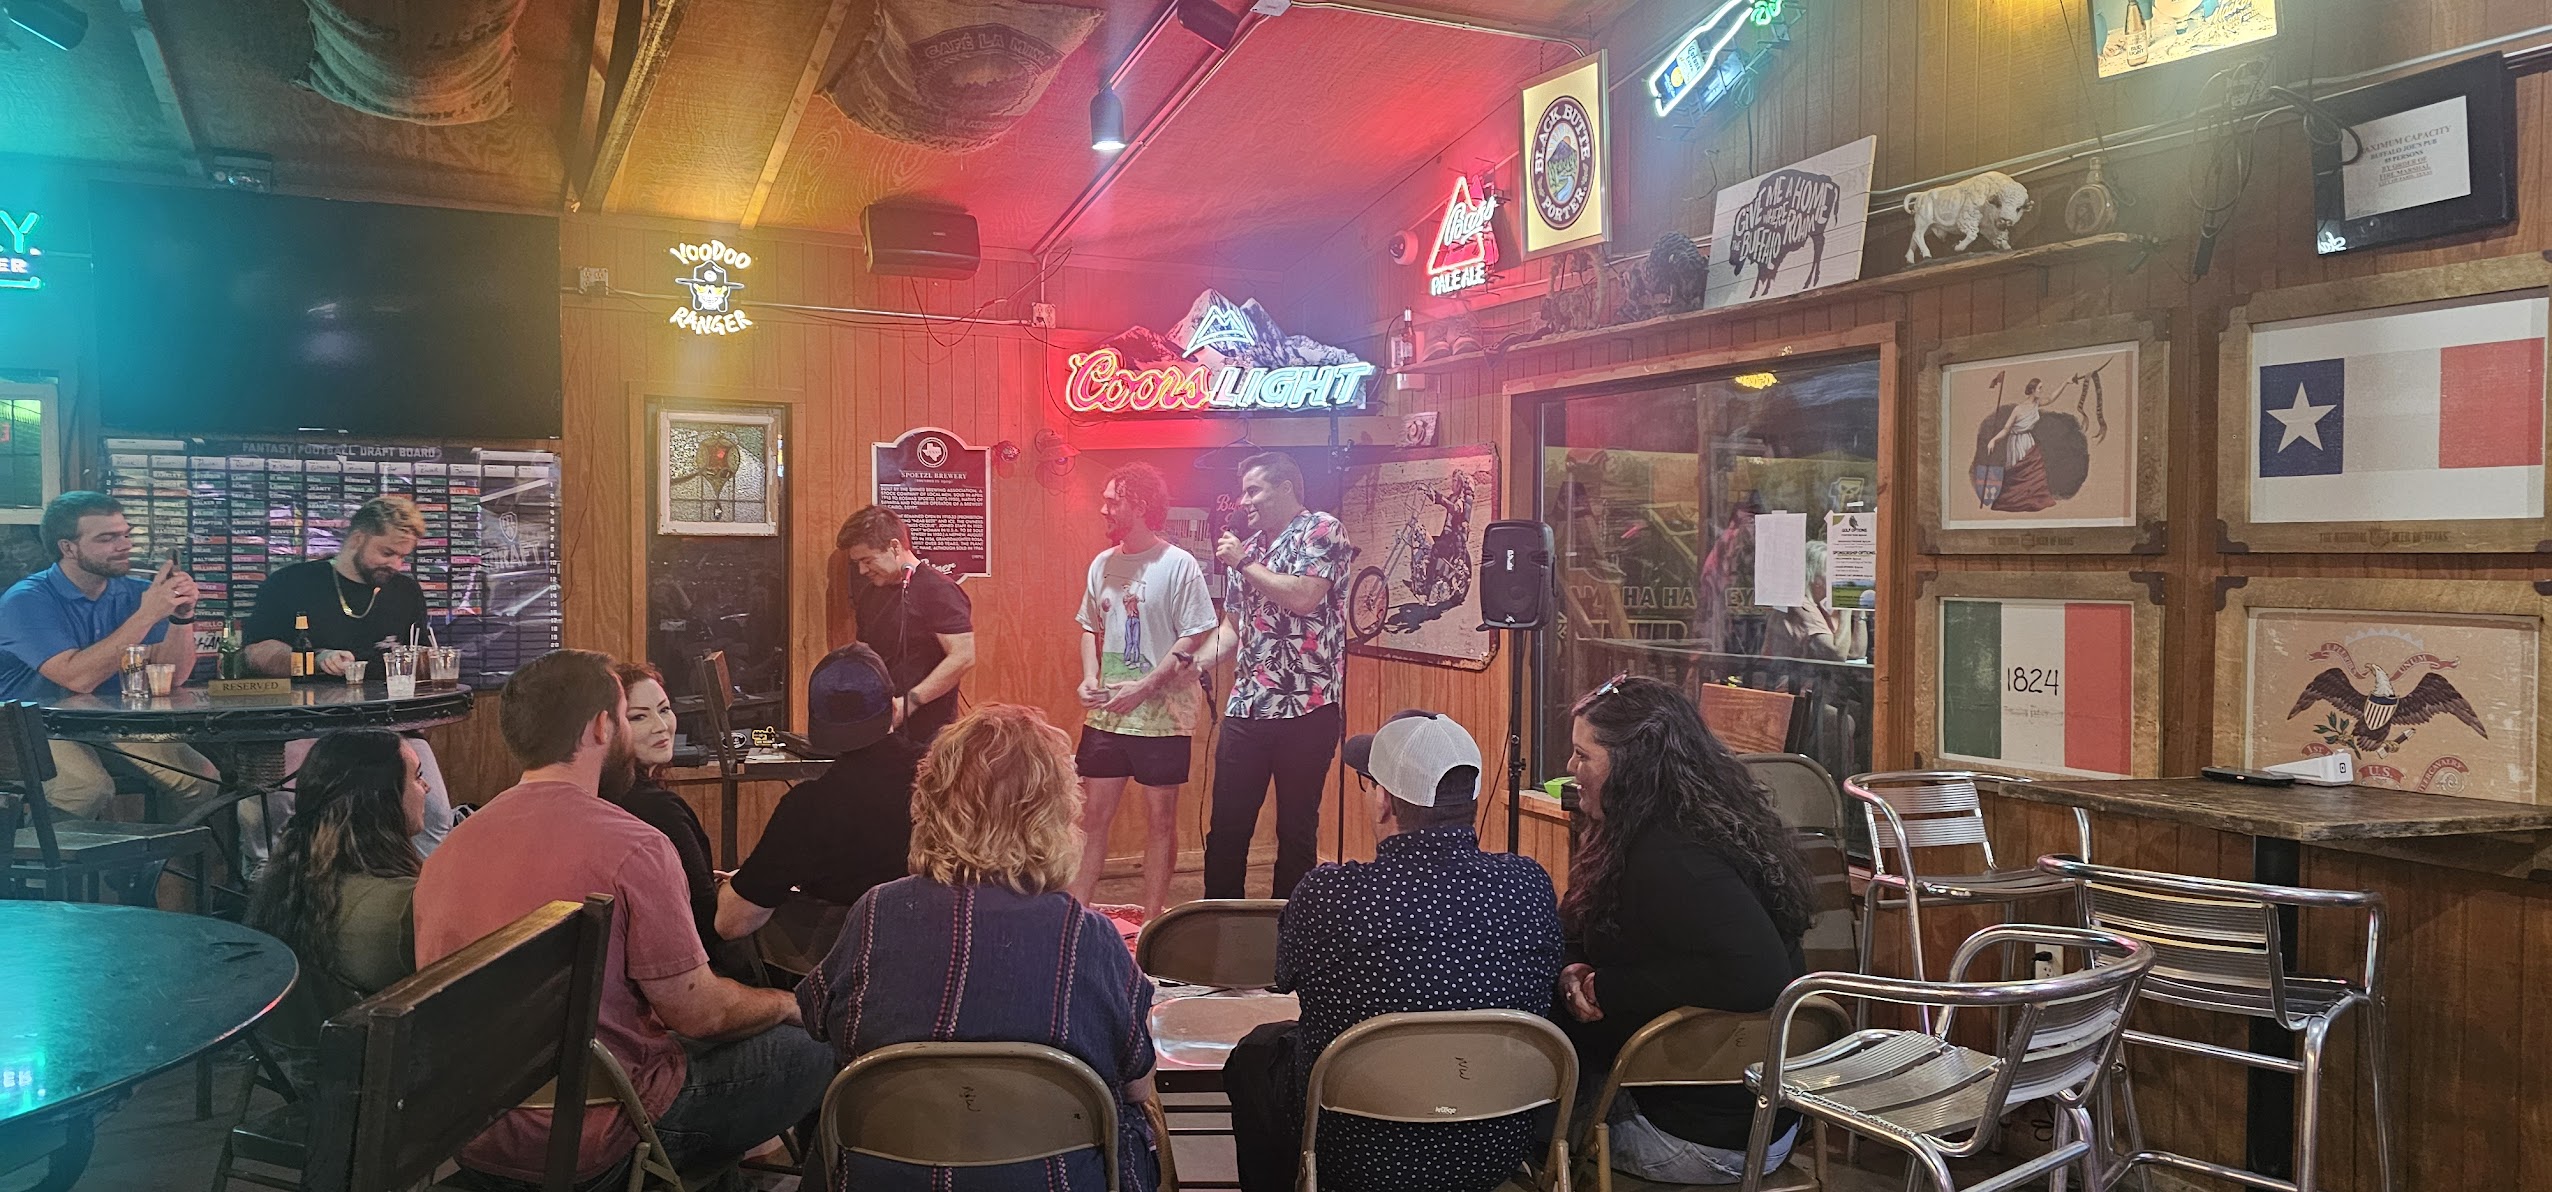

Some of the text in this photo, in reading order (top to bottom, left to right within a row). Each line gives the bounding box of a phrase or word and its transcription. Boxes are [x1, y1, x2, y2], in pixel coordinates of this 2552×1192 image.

[979, 33, 1004, 49] LA
[1534, 103, 1591, 175] BLACK BUTTE
[2363, 125, 2450, 154] AXIMUM CAPACITY
[2370, 147, 2402, 160] BUFFALO
[2423, 138, 2438, 147] PUB
[2392, 150, 2424, 161] PERSONS
[1734, 175, 1836, 236] GIVE ME A HOME
[1762, 202, 1789, 229] WHERE
[1443, 196, 1500, 247] Bass
[669, 239, 752, 269] VOODOO
[1739, 227, 1782, 270] BUFFALO
[1782, 209, 1816, 245] ROAM
[1430, 262, 1486, 296] PALE ALE
[669, 306, 754, 336] RANGER
[1065, 347, 1377, 412] Coors LIGHT
[242, 442, 436, 458] FANTASY FOOTBALL DRAFT BOARD
[934, 472, 967, 480] BREWERY
[2399, 654, 2428, 674] UNUM
[222, 681, 279, 691] RESERVED
[2007, 666, 2059, 696] 1824
